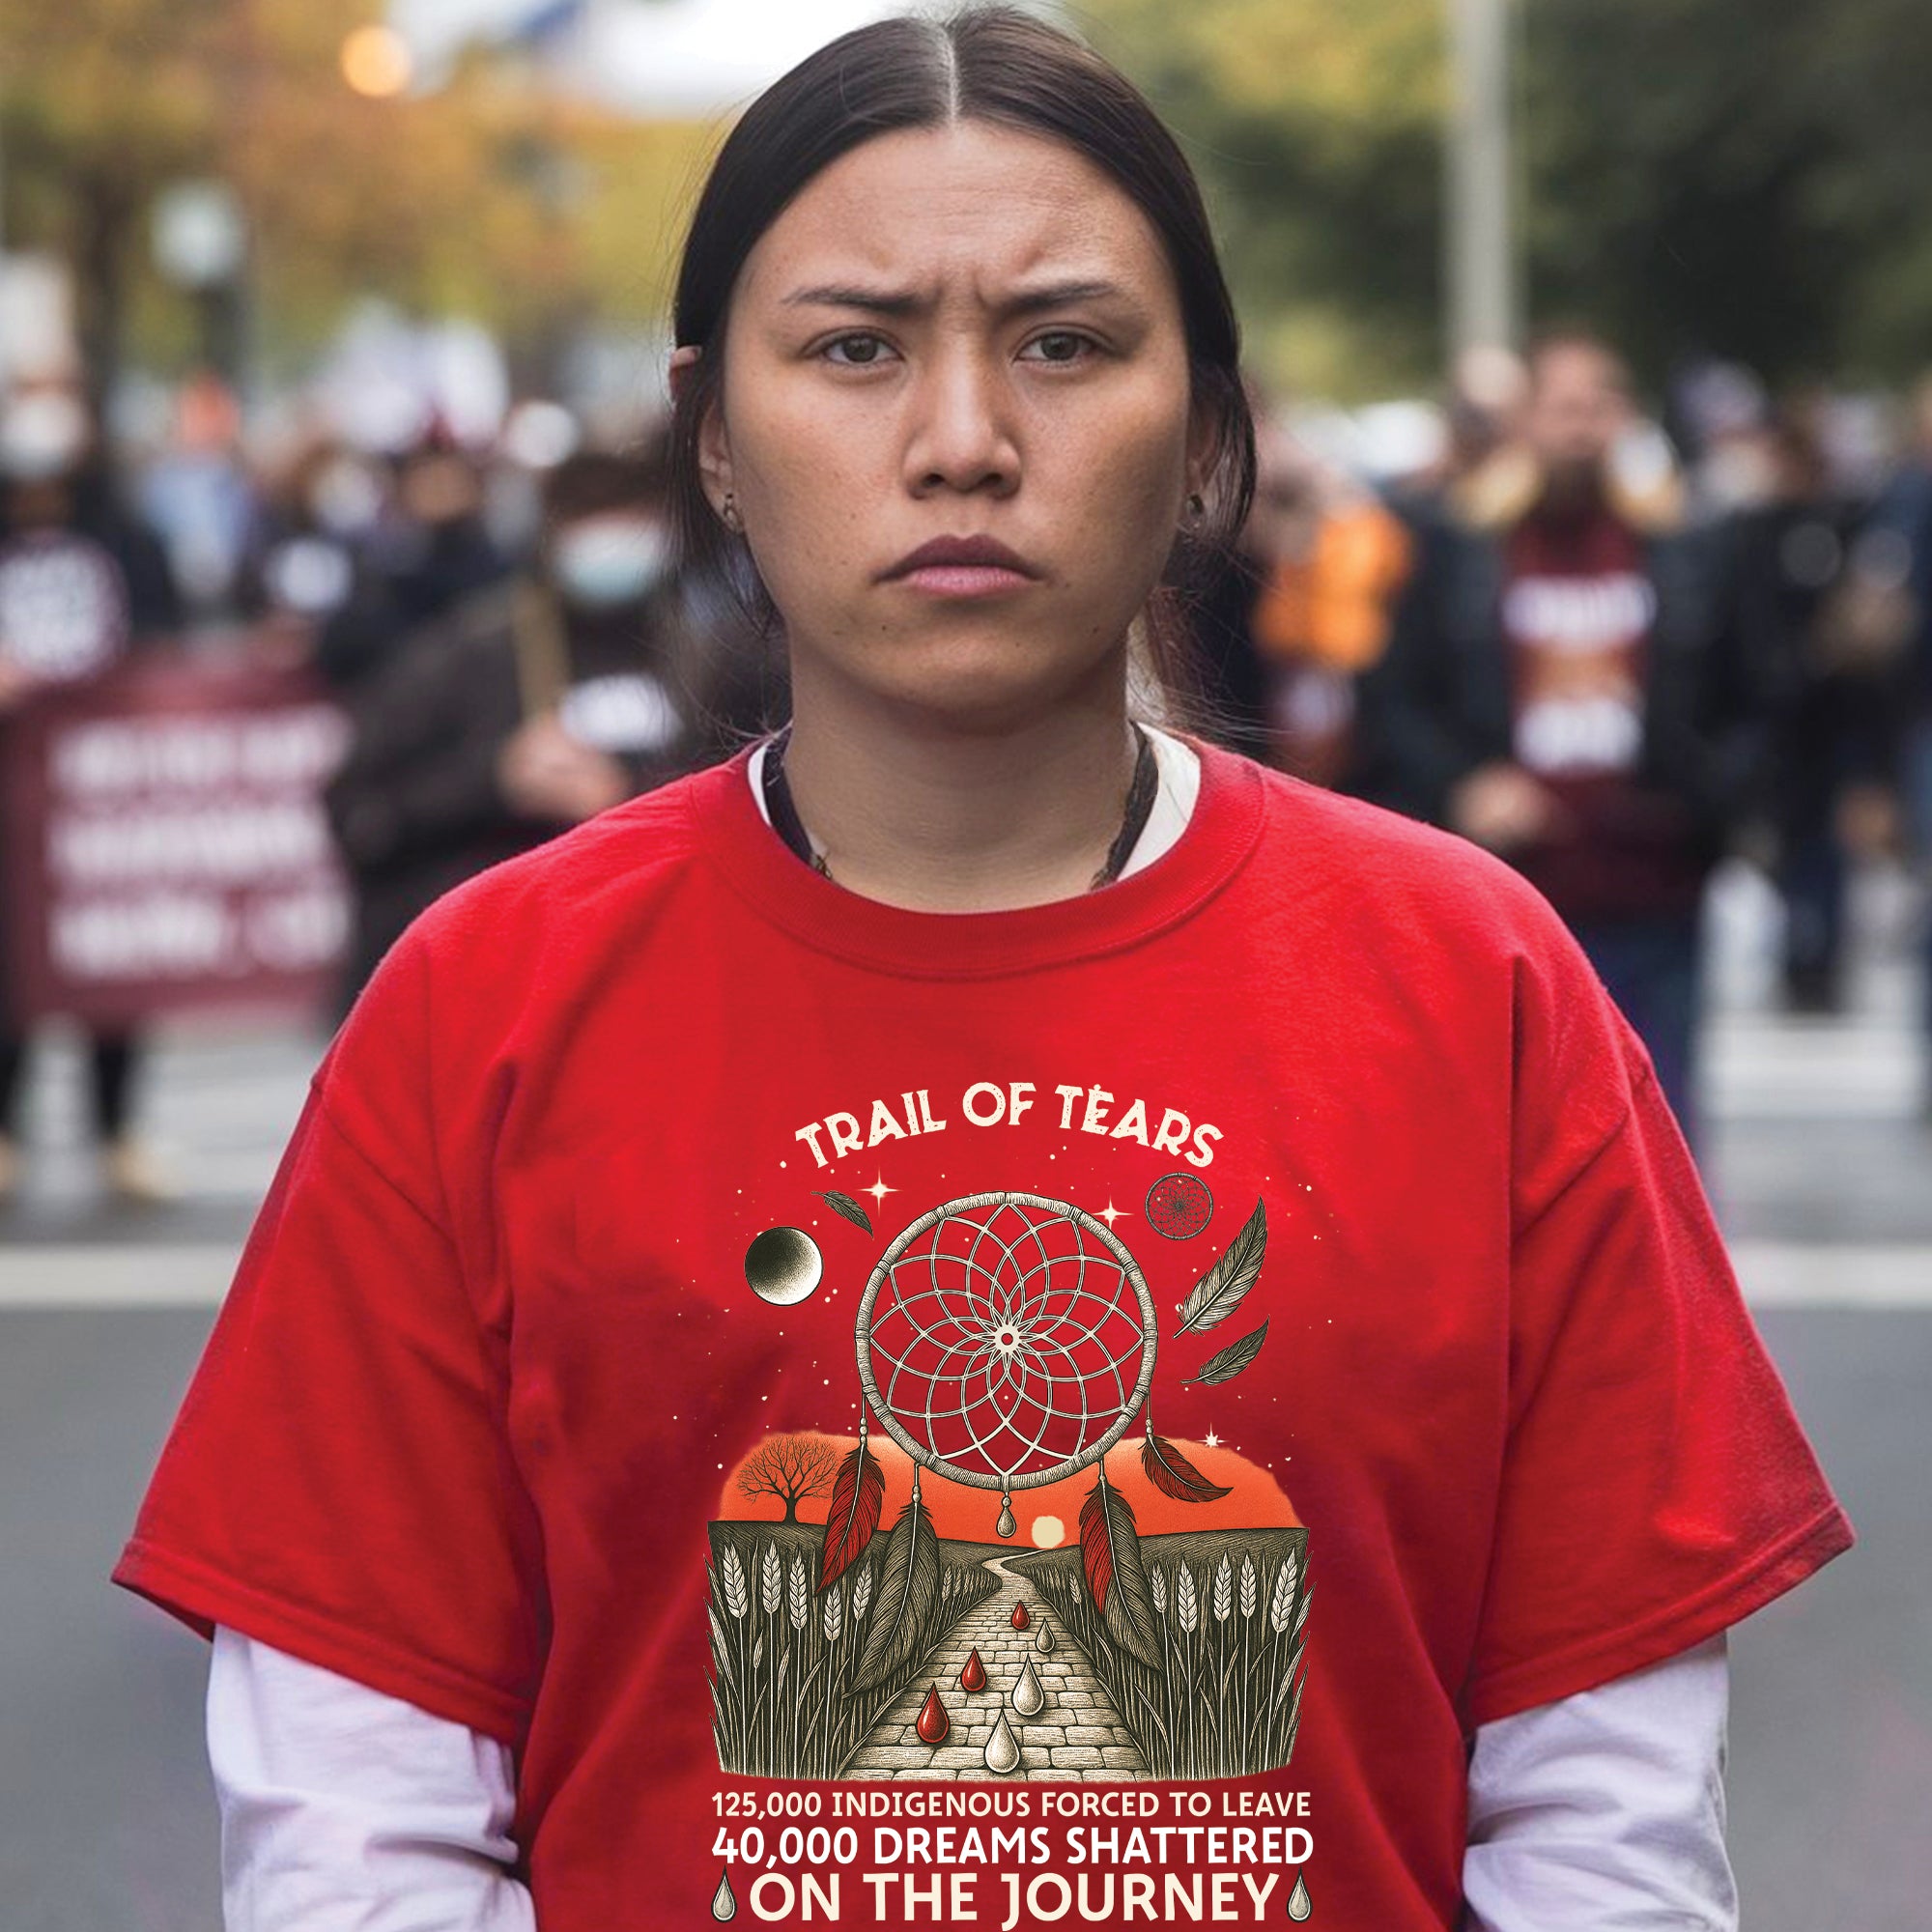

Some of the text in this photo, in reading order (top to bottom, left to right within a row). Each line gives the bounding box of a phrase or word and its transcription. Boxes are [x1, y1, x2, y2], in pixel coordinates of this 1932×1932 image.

[794, 1082, 1224, 1168] TRAIL OF TEARS
[712, 1792, 1311, 1820] 125,000 INDIGENOUS FORCED TO LEAVE
[712, 1827, 1314, 1869] 40,000 DREAMS SHATTERED
[750, 1873, 1280, 1932] ON THE JOURNEY
